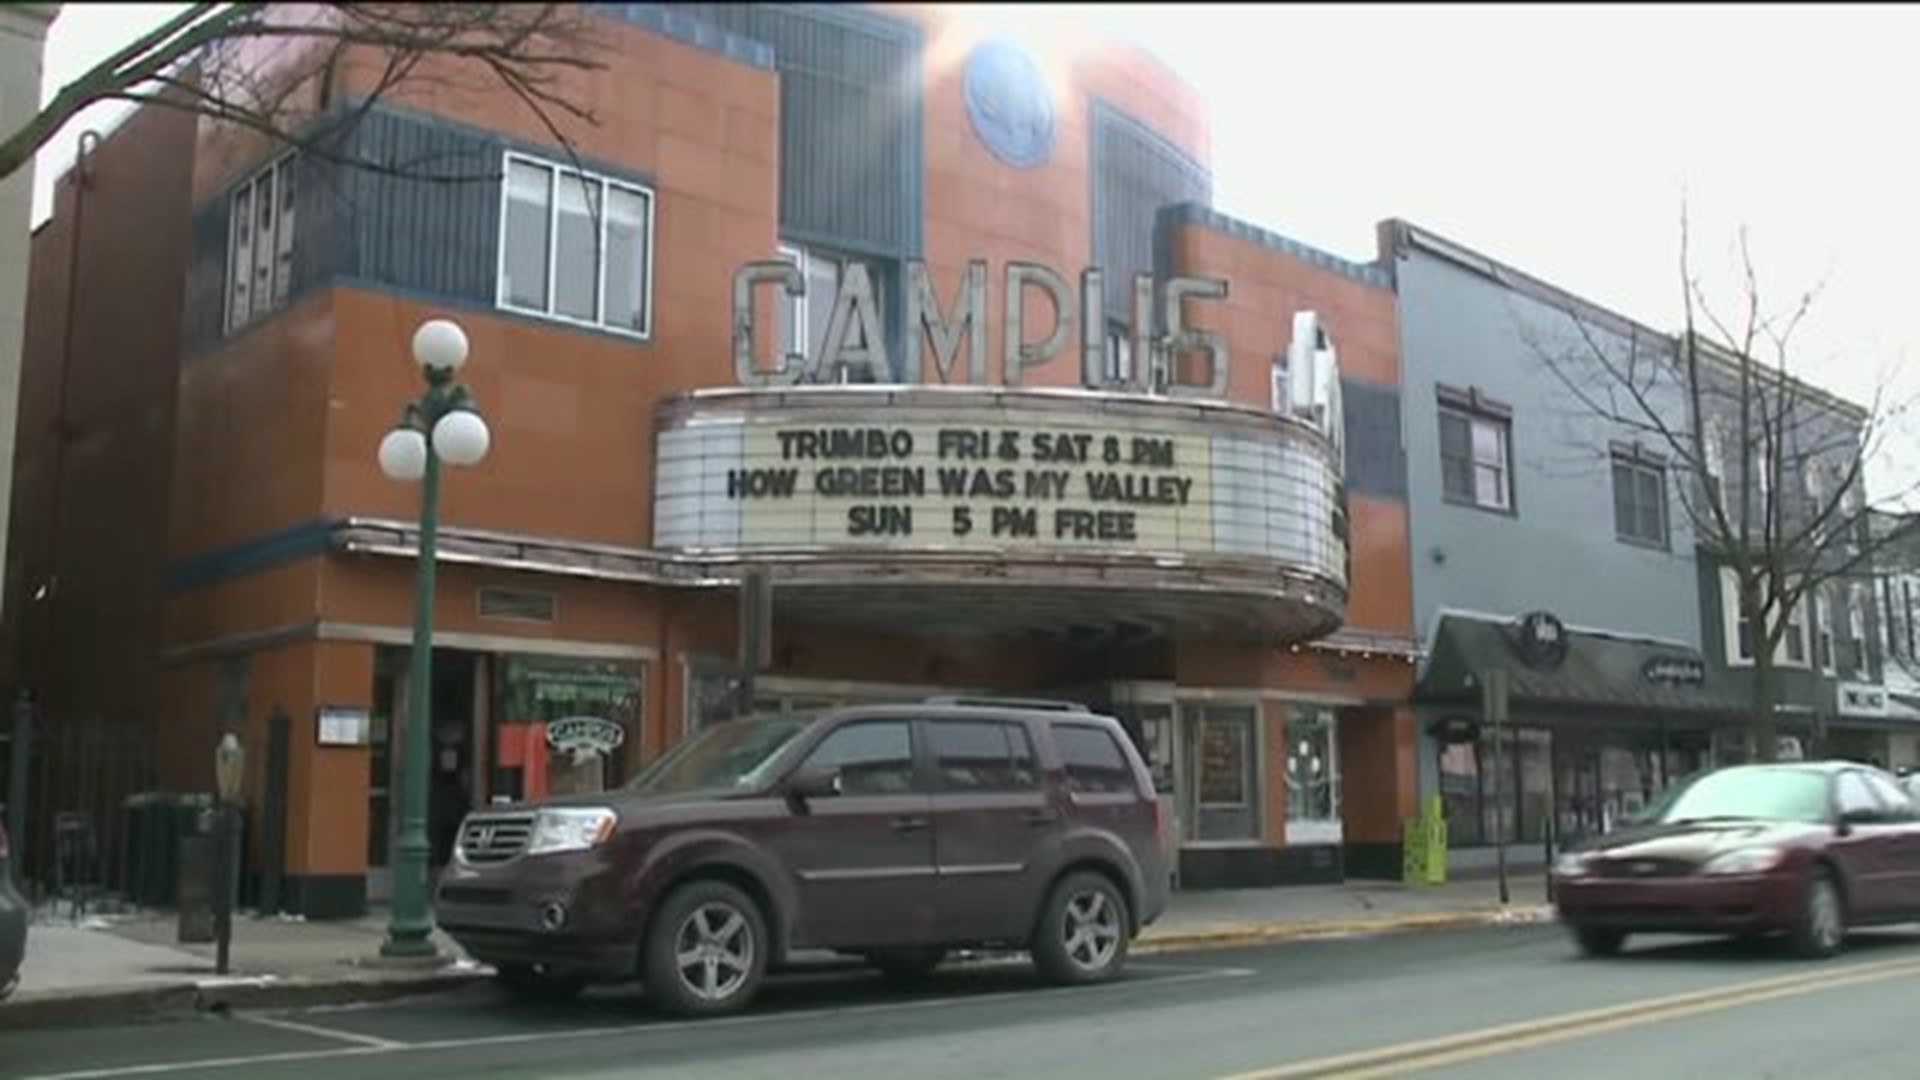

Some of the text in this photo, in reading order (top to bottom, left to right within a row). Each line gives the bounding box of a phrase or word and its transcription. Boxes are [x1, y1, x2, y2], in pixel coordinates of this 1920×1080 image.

[733, 258, 1229, 398] CAMPUS
[776, 429, 913, 460] TRUMBO
[938, 429, 990, 460] FRI
[1032, 433, 1092, 463] SAT
[1102, 435, 1120, 465] 8
[1131, 437, 1174, 467] PM
[727, 466, 1192, 506] HOW GREEN WAS MY VALLEY
[847, 505, 1137, 540] SUN 5 PM FREE
